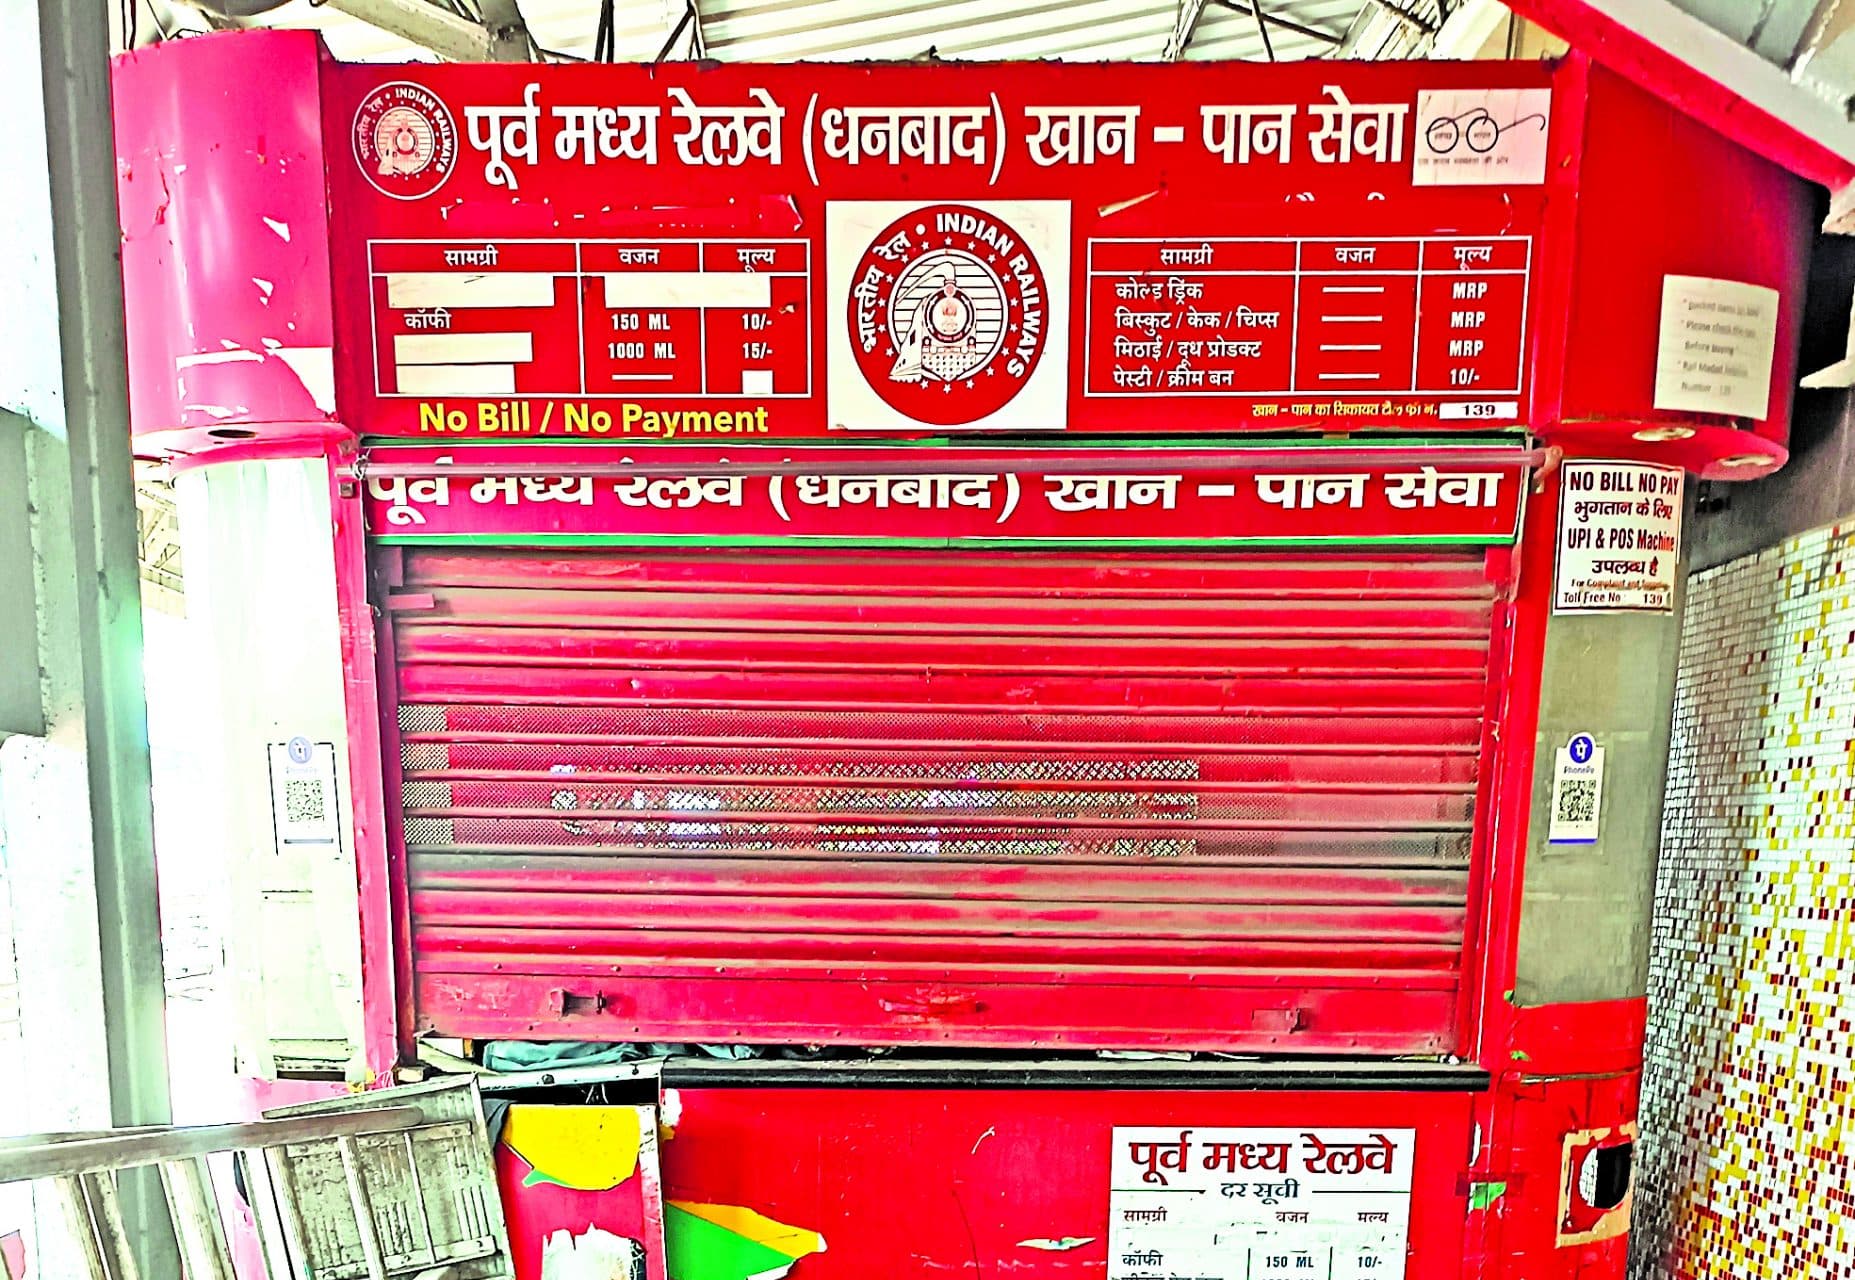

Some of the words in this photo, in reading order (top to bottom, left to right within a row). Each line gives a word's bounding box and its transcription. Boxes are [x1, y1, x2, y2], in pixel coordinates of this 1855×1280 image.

[395, 88, 435, 110] INDIAN
[433, 109, 452, 173] RAILWAYS
[464, 83, 540, 189] पूर्व
[552, 105, 660, 165] मध्य
[668, 88, 785, 167] रेलवे
[802, 92, 1006, 186] (धनबाद)
[1024, 106, 1141, 165] खान
[1201, 104, 1297, 163] पान
[1308, 85, 1409, 163] सेवा
[444, 244, 498, 266] सामग्री
[618, 248, 660, 265] वजन
[737, 248, 776, 274] मूल्य
[1160, 243, 1214, 265] सामग्री
[1335, 247, 1375, 263] वजन
[1453, 246, 1493, 271] मूल्य
[936, 213, 1014, 257] INDIAN
[1006, 254, 1041, 378] RAILWAYS
[1452, 282, 1487, 299] MRP
[404, 307, 451, 330] कॉफी
[854, 264, 885, 353] भारतीय
[611, 313, 641, 331] 150
[648, 313, 670, 331] ML
[742, 313, 773, 331] 10/-
[1114, 306, 1172, 336] बिस्कुट
[1186, 305, 1222, 328] केक
[1236, 305, 1280, 328] चिप्स
[1450, 312, 1485, 328] MRP
[607, 342, 645, 360] 1000
[653, 342, 676, 360] ML
[742, 342, 773, 360] 15/-
[1113, 335, 1163, 362] मिठाई
[1177, 341, 1204, 367] दूध
[1449, 340, 1484, 356] MRP
[1167, 364, 1205, 387] क्रीम
[1208, 370, 1234, 386] बन
[1450, 370, 1480, 386] 10/-
[420, 403, 467, 431] No
[479, 402, 530, 431] Bill
[539, 402, 554, 433] /
[564, 404, 611, 432] No
[622, 405, 769, 438] Payment
[1461, 405, 1496, 417] 139
[1044, 474, 1181, 511] खान
[1254, 473, 1370, 508] पान
[1384, 466, 1504, 508] सेवा
[1570, 471, 1594, 491] NO
[1600, 472, 1633, 491] BILL
[1638, 473, 1657, 493] NO
[1660, 475, 1679, 496] PAY
[1574, 501, 1633, 522] भुगतान
[1636, 497, 1650, 516] के
[1653, 498, 1673, 520] लिए
[1568, 528, 1591, 549] UPI
[1595, 528, 1605, 549] &
[1609, 528, 1634, 549] POS
[1637, 529, 1674, 552] Machine
[1129, 1130, 1192, 1186] पूर्व
[1202, 1142, 1291, 1173] मध्य
[1300, 1133, 1397, 1174] रेलवे
[1221, 1183, 1248, 1199] दर
[1124, 1206, 1168, 1221] सामग्री
[1275, 1212, 1309, 1223] वजन
[1122, 1250, 1163, 1266] कॉफी
[1266, 1256, 1288, 1268] 150
[1296, 1256, 1314, 1268] ML
[1358, 1256, 1382, 1268] 10/-
